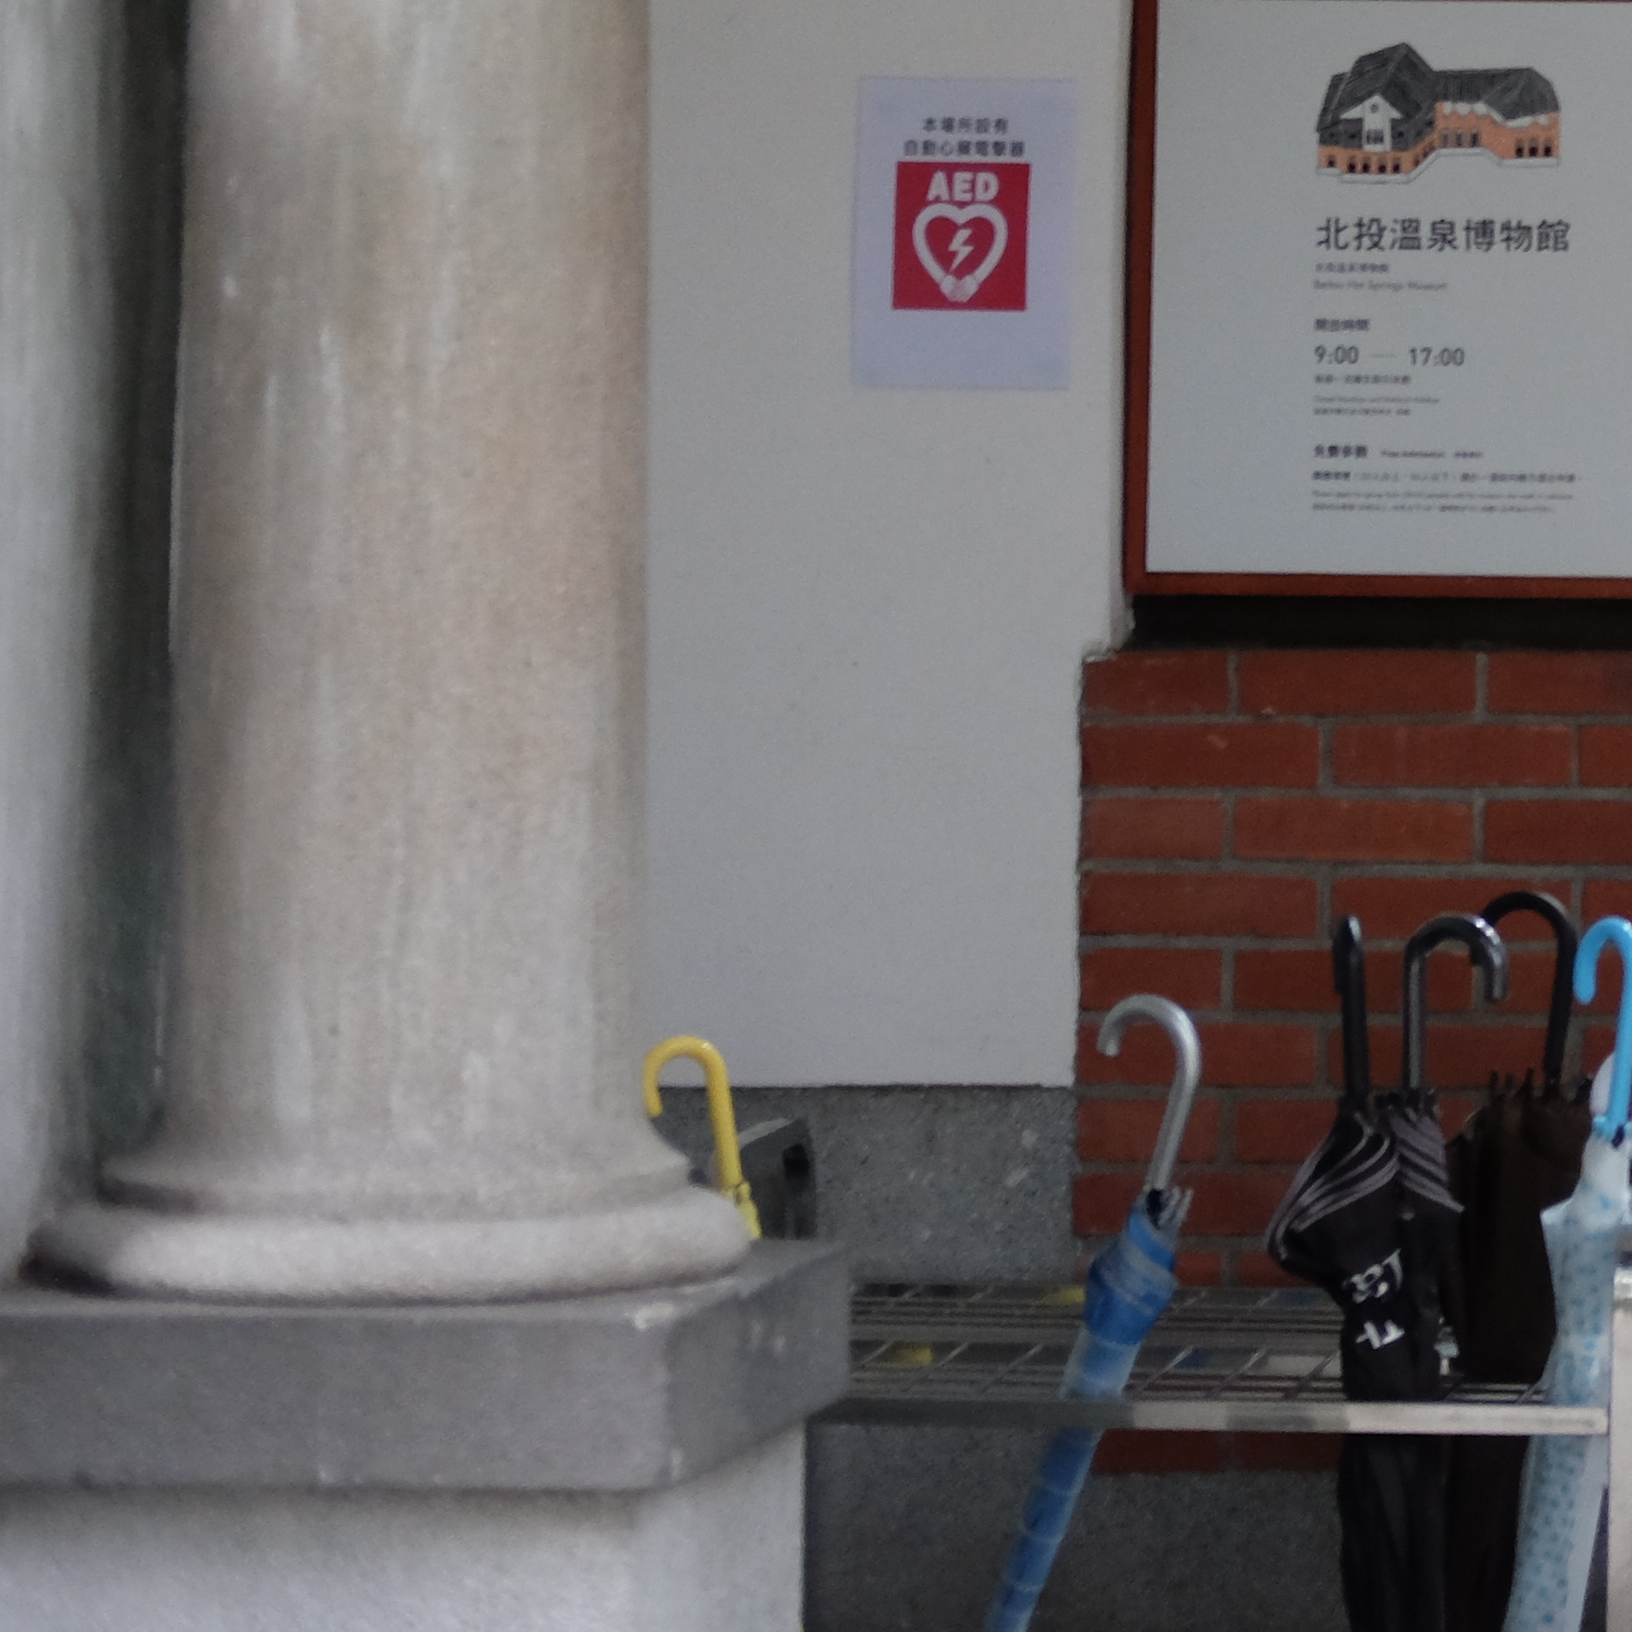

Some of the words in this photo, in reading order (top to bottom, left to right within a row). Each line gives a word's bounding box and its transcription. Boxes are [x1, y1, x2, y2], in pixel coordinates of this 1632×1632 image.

[926, 170, 1000, 203] AED
[1316, 216, 1572, 253] 北投溫泉博物館
[1314, 344, 1360, 365] 9:00
[1408, 346, 1466, 367] 17:00
